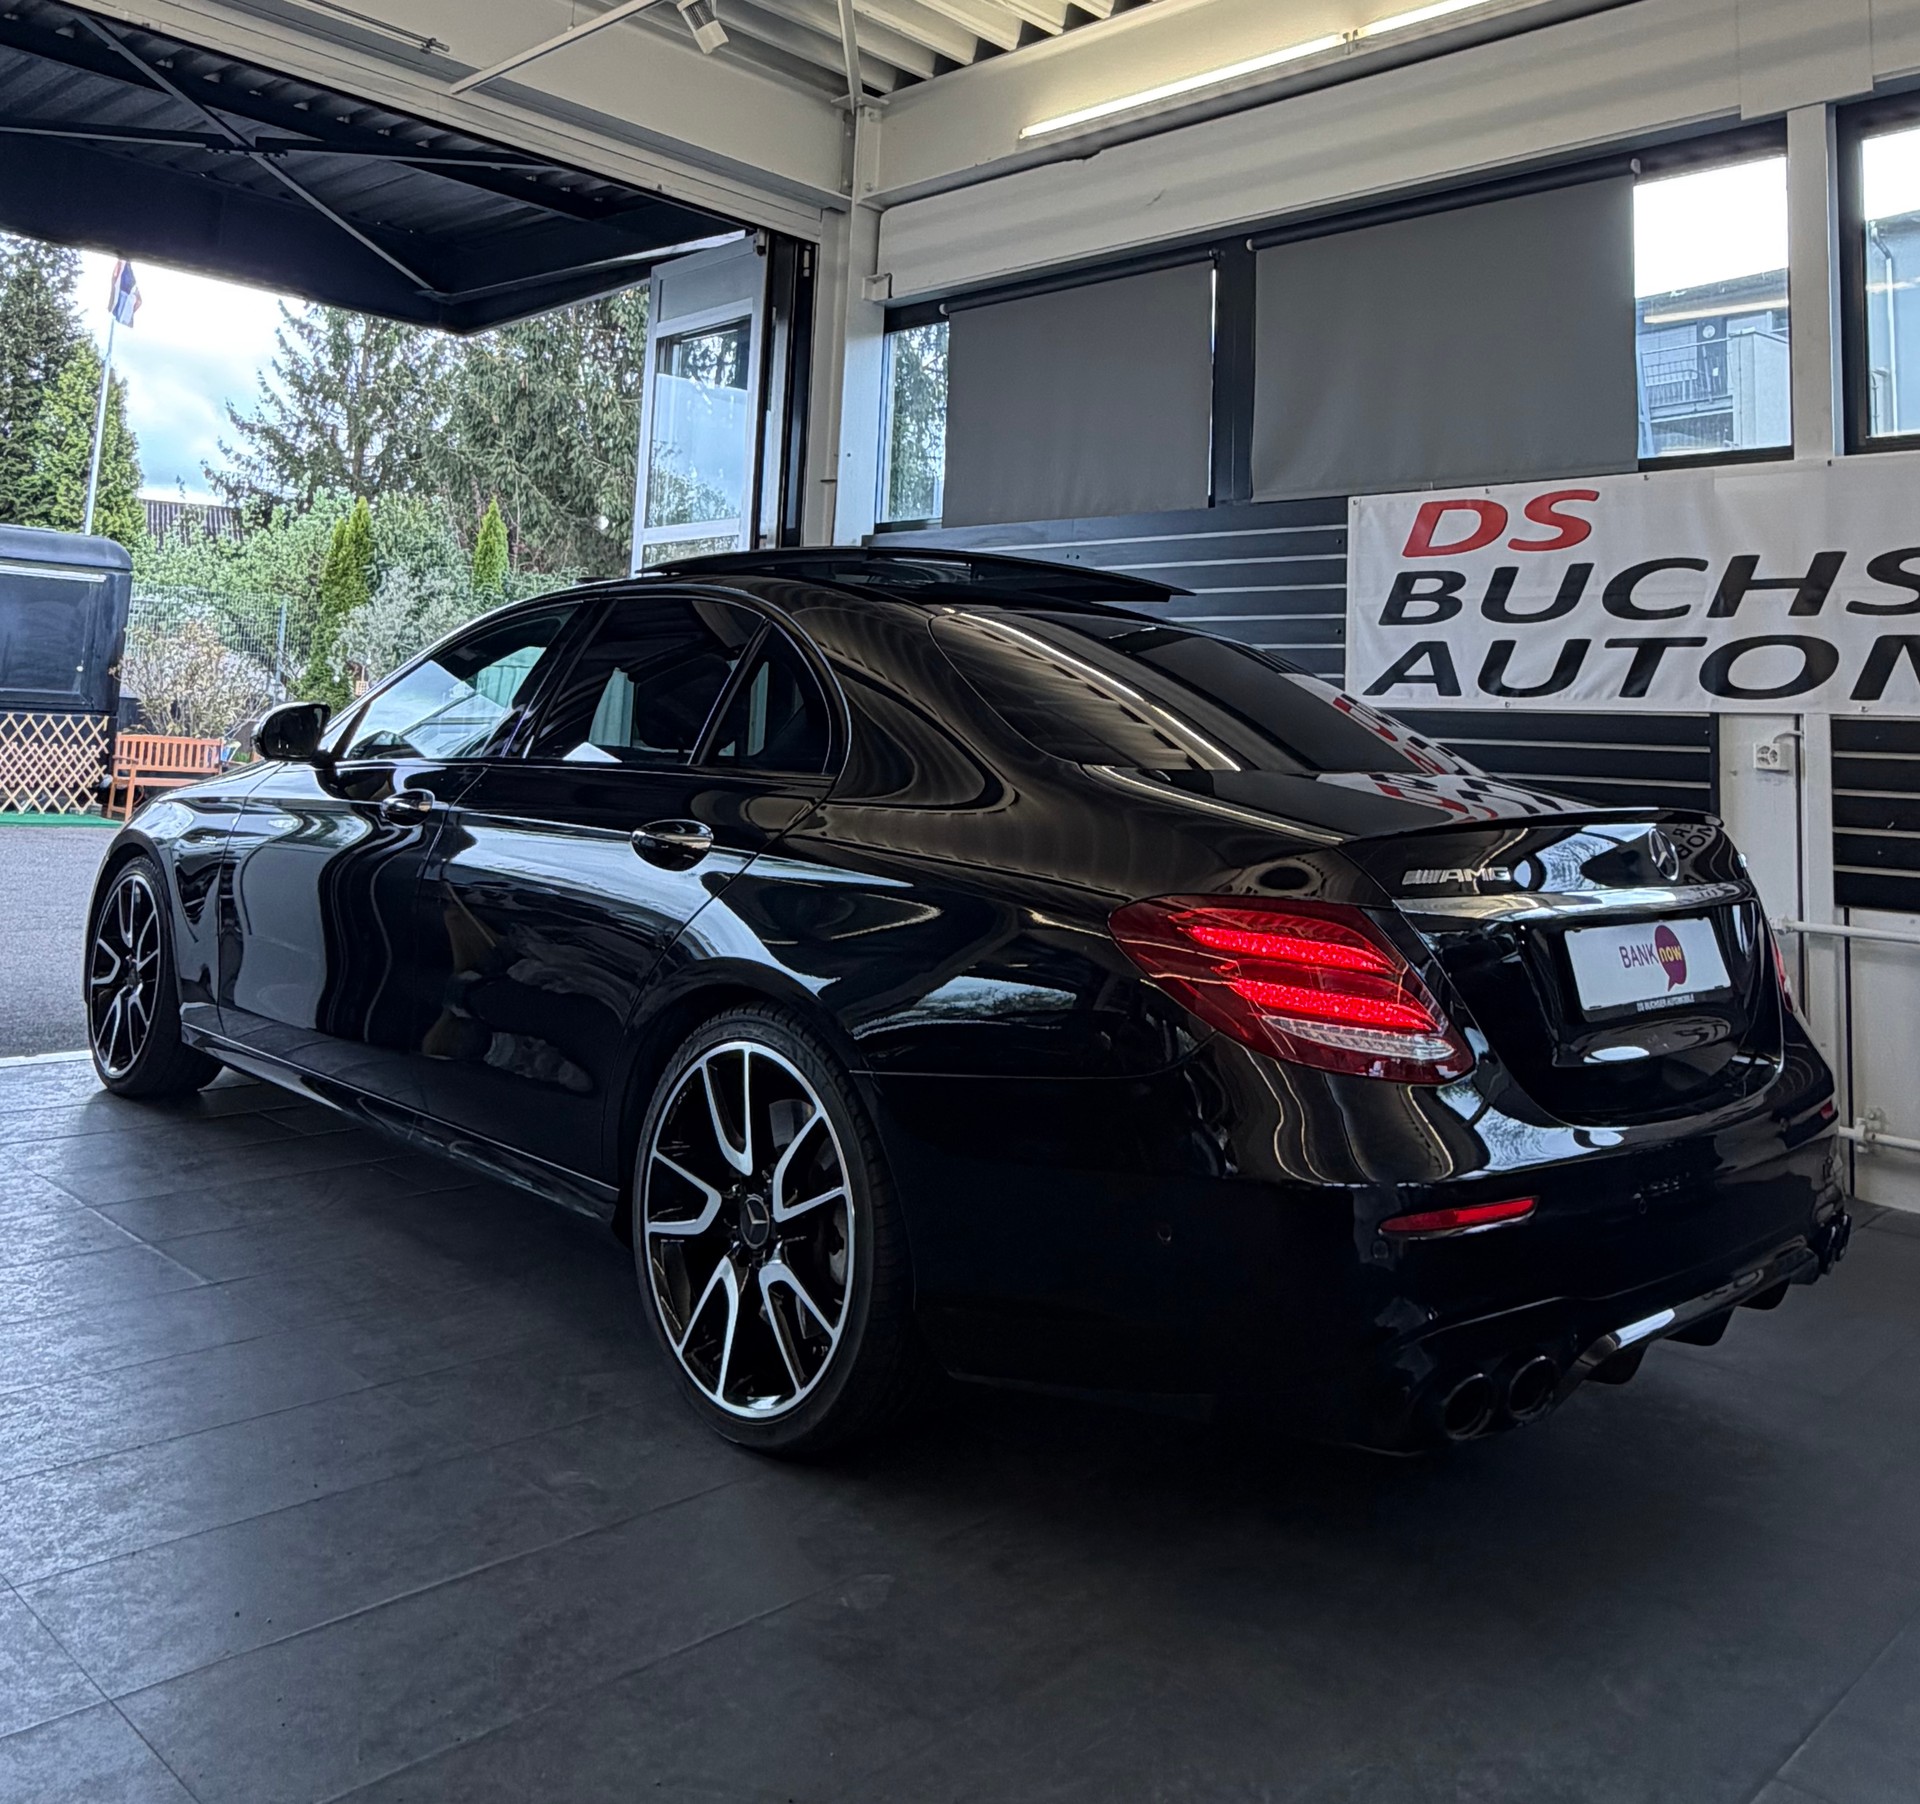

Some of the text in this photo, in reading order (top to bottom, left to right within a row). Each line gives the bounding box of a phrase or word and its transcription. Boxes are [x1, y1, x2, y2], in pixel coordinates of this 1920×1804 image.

[1402, 490, 1599, 557] DS
[1379, 547, 1920, 626] BUCHS
[1619, 943, 1682, 968] BANK now
